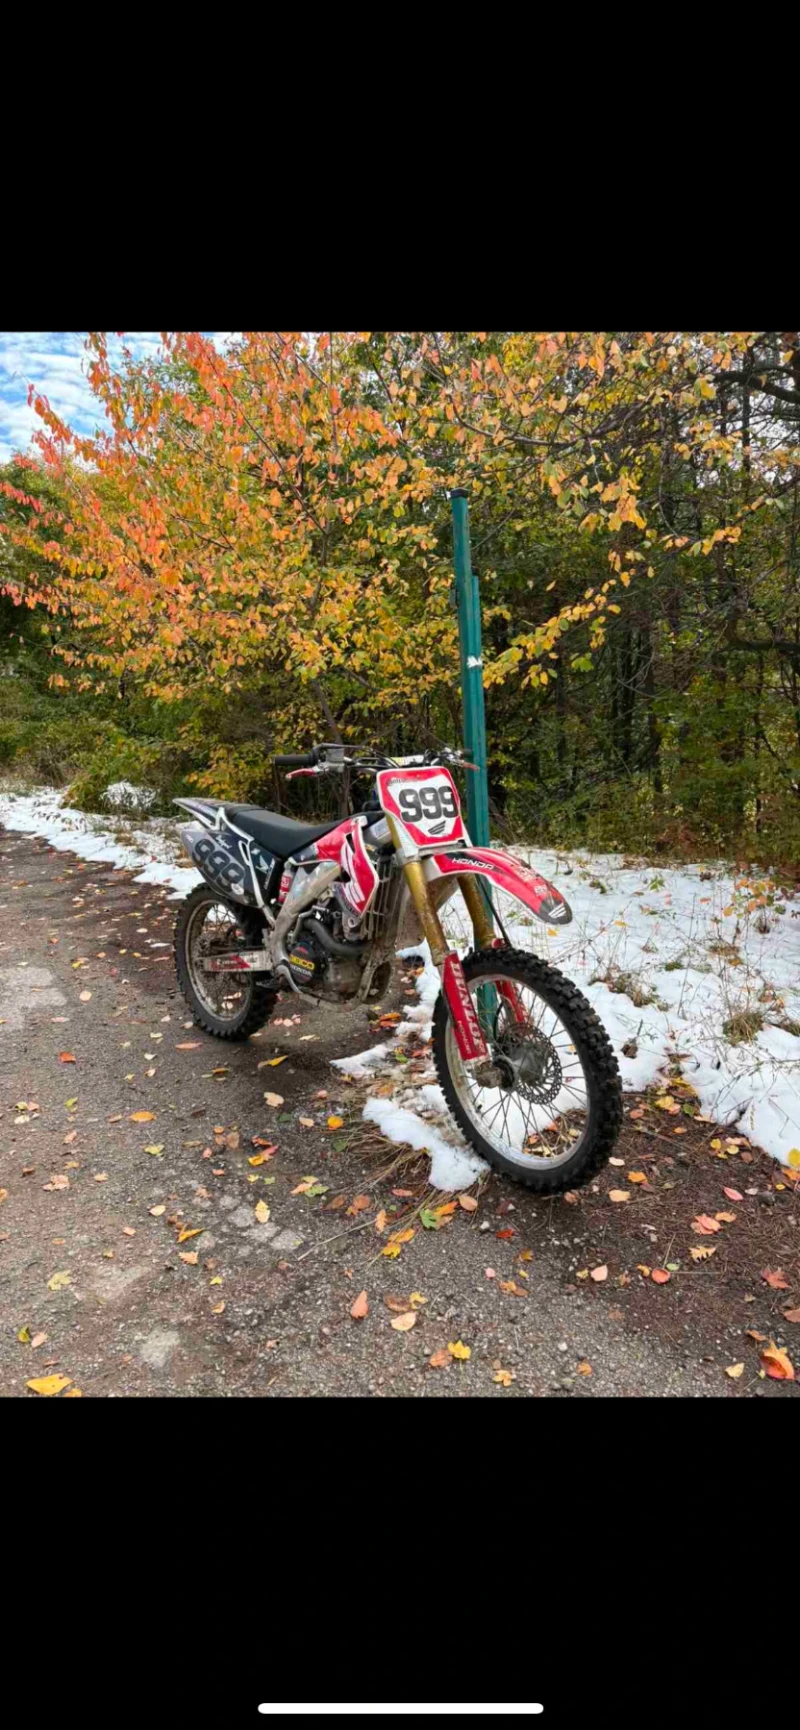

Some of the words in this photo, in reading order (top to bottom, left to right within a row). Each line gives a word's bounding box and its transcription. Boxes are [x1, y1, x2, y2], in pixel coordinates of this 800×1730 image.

[399, 786, 458, 822] 999
[194, 839, 245, 892] 999
[452, 857, 495, 871] HONDA
[450, 960, 482, 1047] DUNLOP
